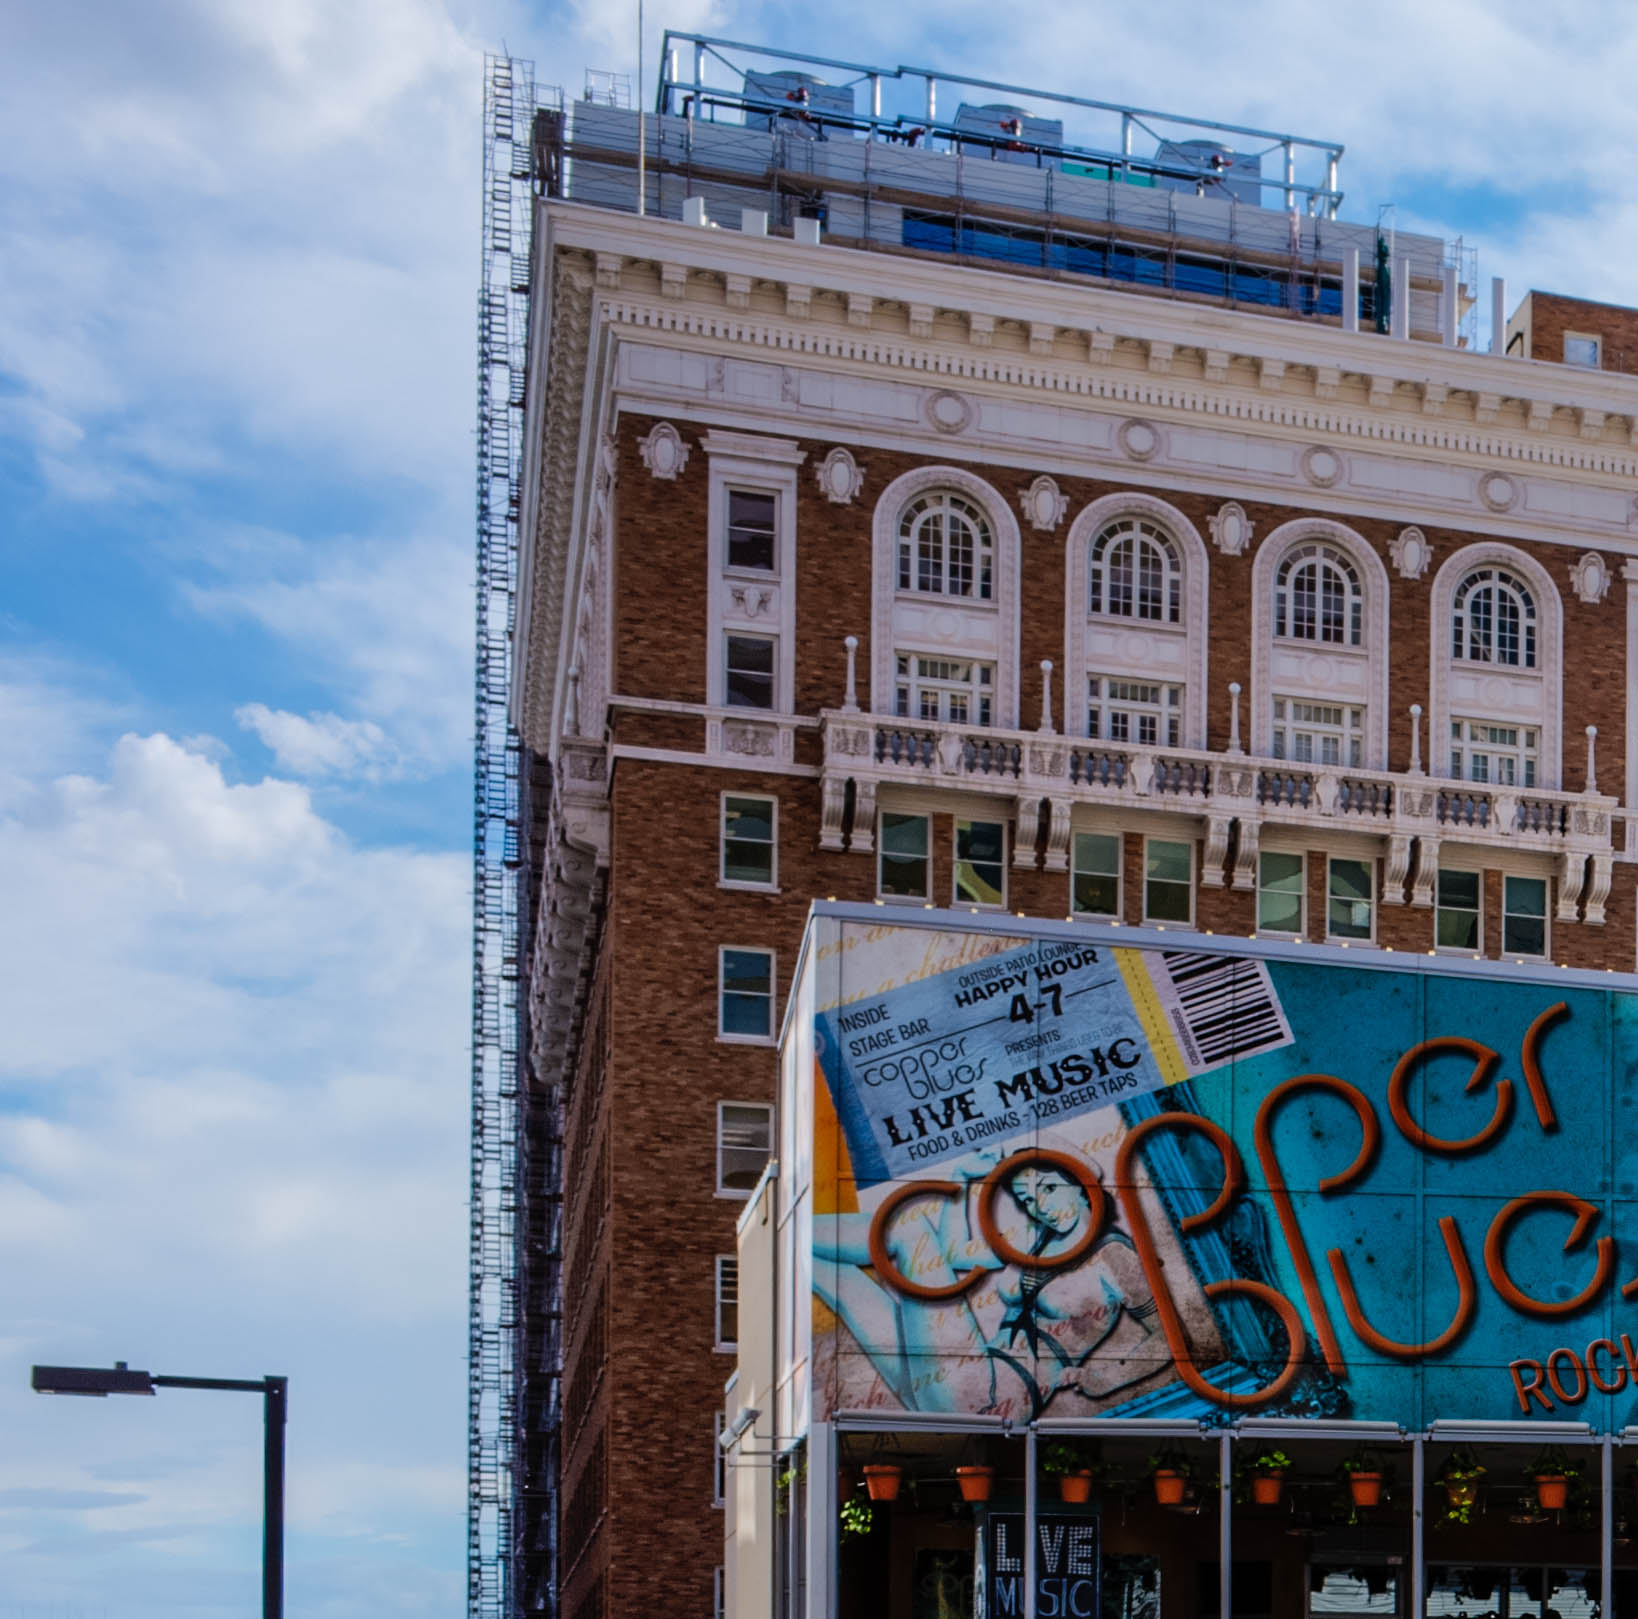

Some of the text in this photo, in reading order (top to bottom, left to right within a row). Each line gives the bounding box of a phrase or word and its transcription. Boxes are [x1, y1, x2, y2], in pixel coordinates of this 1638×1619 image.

[954, 949, 1100, 1008] HAPPY HOUR
[959, 943, 1083, 989] OUTSIDE PATIO LOUNGE
[839, 1003, 891, 1034] INSIDE
[1008, 983, 1066, 1025] 4-7
[849, 1017, 931, 1057] STAGE BAR
[1004, 1028, 1061, 1056] PRESENTS
[863, 1036, 968, 1089] copper
[906, 1056, 989, 1100] blues
[882, 1085, 985, 1148] LIVE
[993, 1037, 1142, 1108] MUSIC
[907, 1134, 951, 1162] FOOD
[953, 1130, 966, 1147] &
[965, 1112, 1021, 1143] DRINKS
[1032, 1098, 1060, 1120] 128
[1060, 1085, 1099, 1110] BEER
[1098, 1071, 1138, 1093] TAPS
[868, 1001, 1574, 1300] copper
[996, 1522, 1094, 1576] LVE
